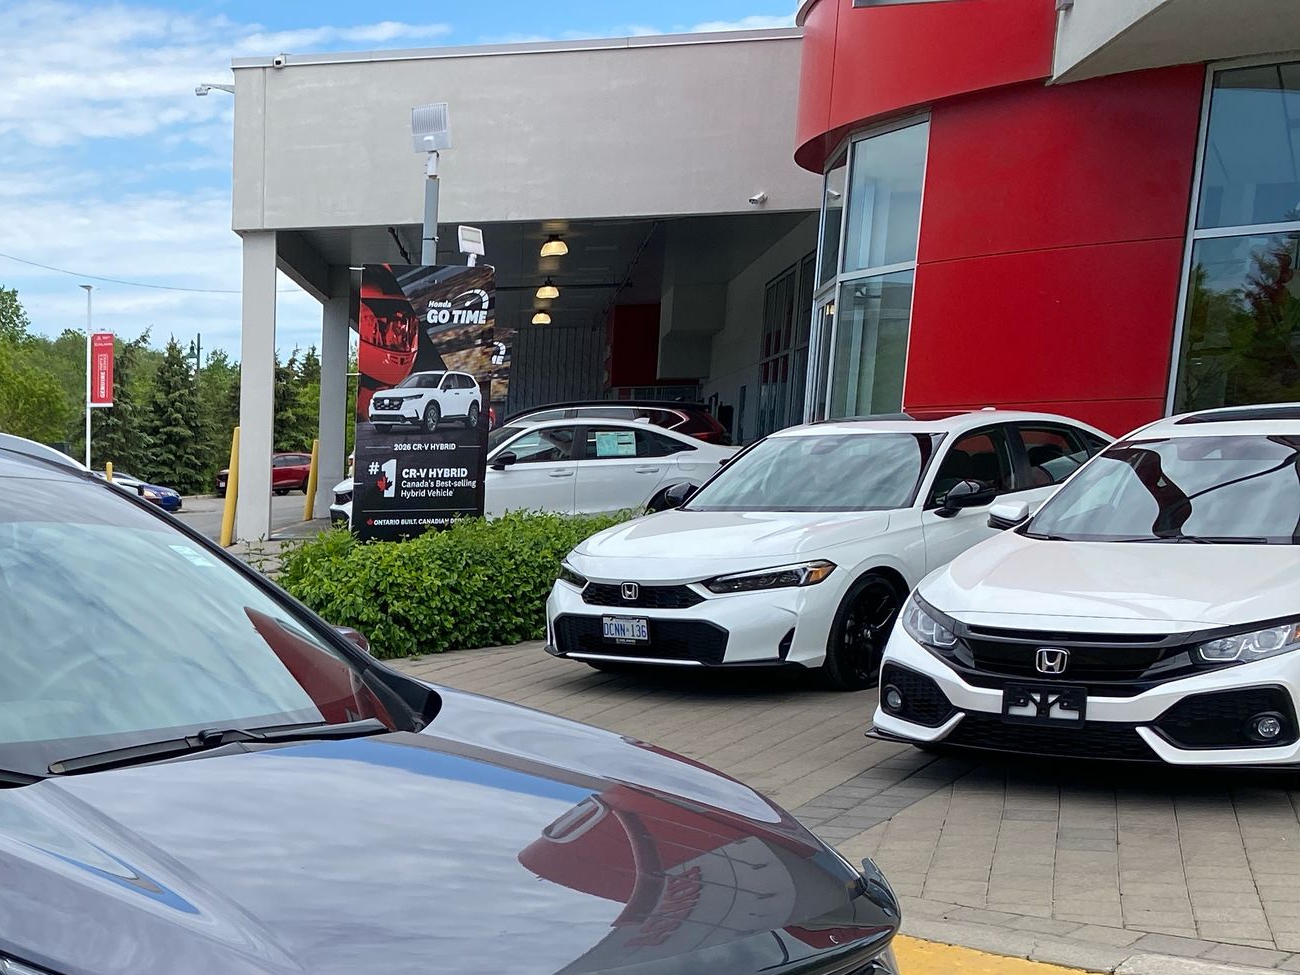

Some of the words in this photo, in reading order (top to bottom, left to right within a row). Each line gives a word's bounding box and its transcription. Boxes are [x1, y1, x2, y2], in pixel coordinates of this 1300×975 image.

[428, 300, 452, 308] Honda
[426, 309, 450, 324] GO
[452, 309, 488, 325] TIME
[393, 443, 412, 451] 2026
[412, 443, 430, 451] CR-V
[430, 443, 456, 451] HYBRID
[401, 468, 427, 478] CR-V
[428, 468, 468, 478] HYBRID
[368, 459, 397, 498] #1
[401, 479, 435, 488] Canada's
[435, 479, 477, 489] Best-selling
[400, 489, 426, 499] Hybrid
